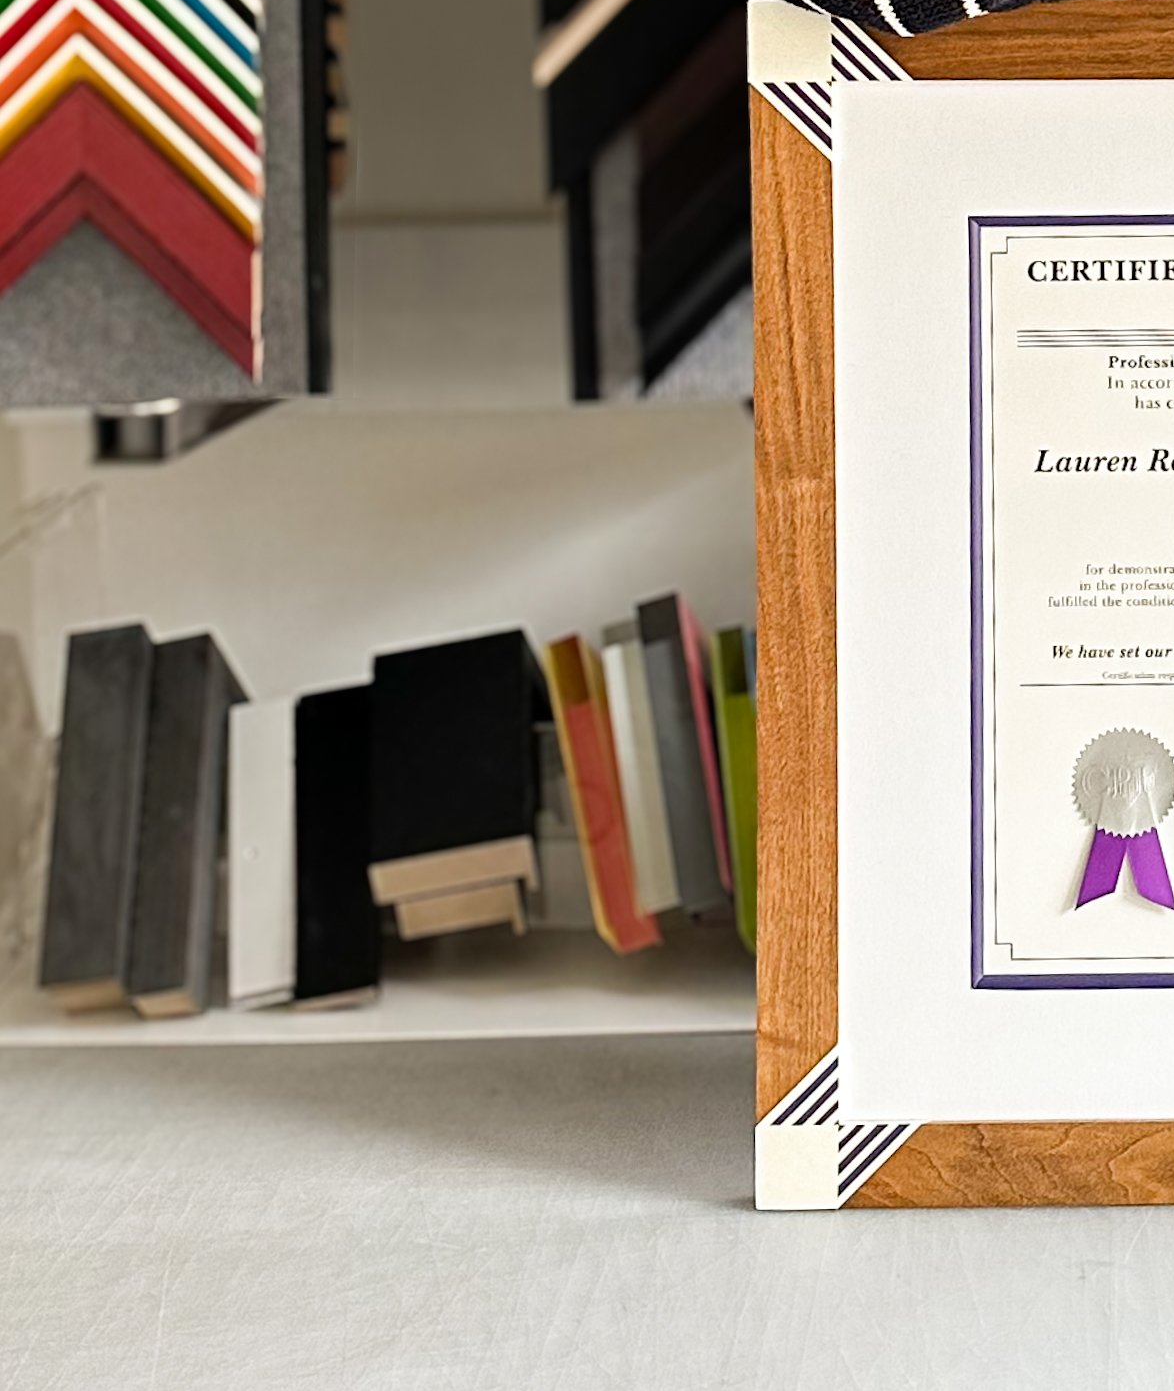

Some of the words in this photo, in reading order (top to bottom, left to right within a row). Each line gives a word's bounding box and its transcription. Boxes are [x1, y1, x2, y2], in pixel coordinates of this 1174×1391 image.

[1108, 376, 1124, 389] In
[1135, 396, 1160, 409] has
[1034, 450, 1137, 472] Lauren
[1086, 564, 1104, 575] for
[1080, 581, 1091, 591] in
[1097, 580, 1116, 591] the
[1049, 596, 1097, 607] fulfilled
[1102, 596, 1122, 607] the
[1053, 646, 1073, 658] We
[1078, 645, 1114, 658] have
[1120, 646, 1139, 658] set
[1145, 649, 1172, 657] our
